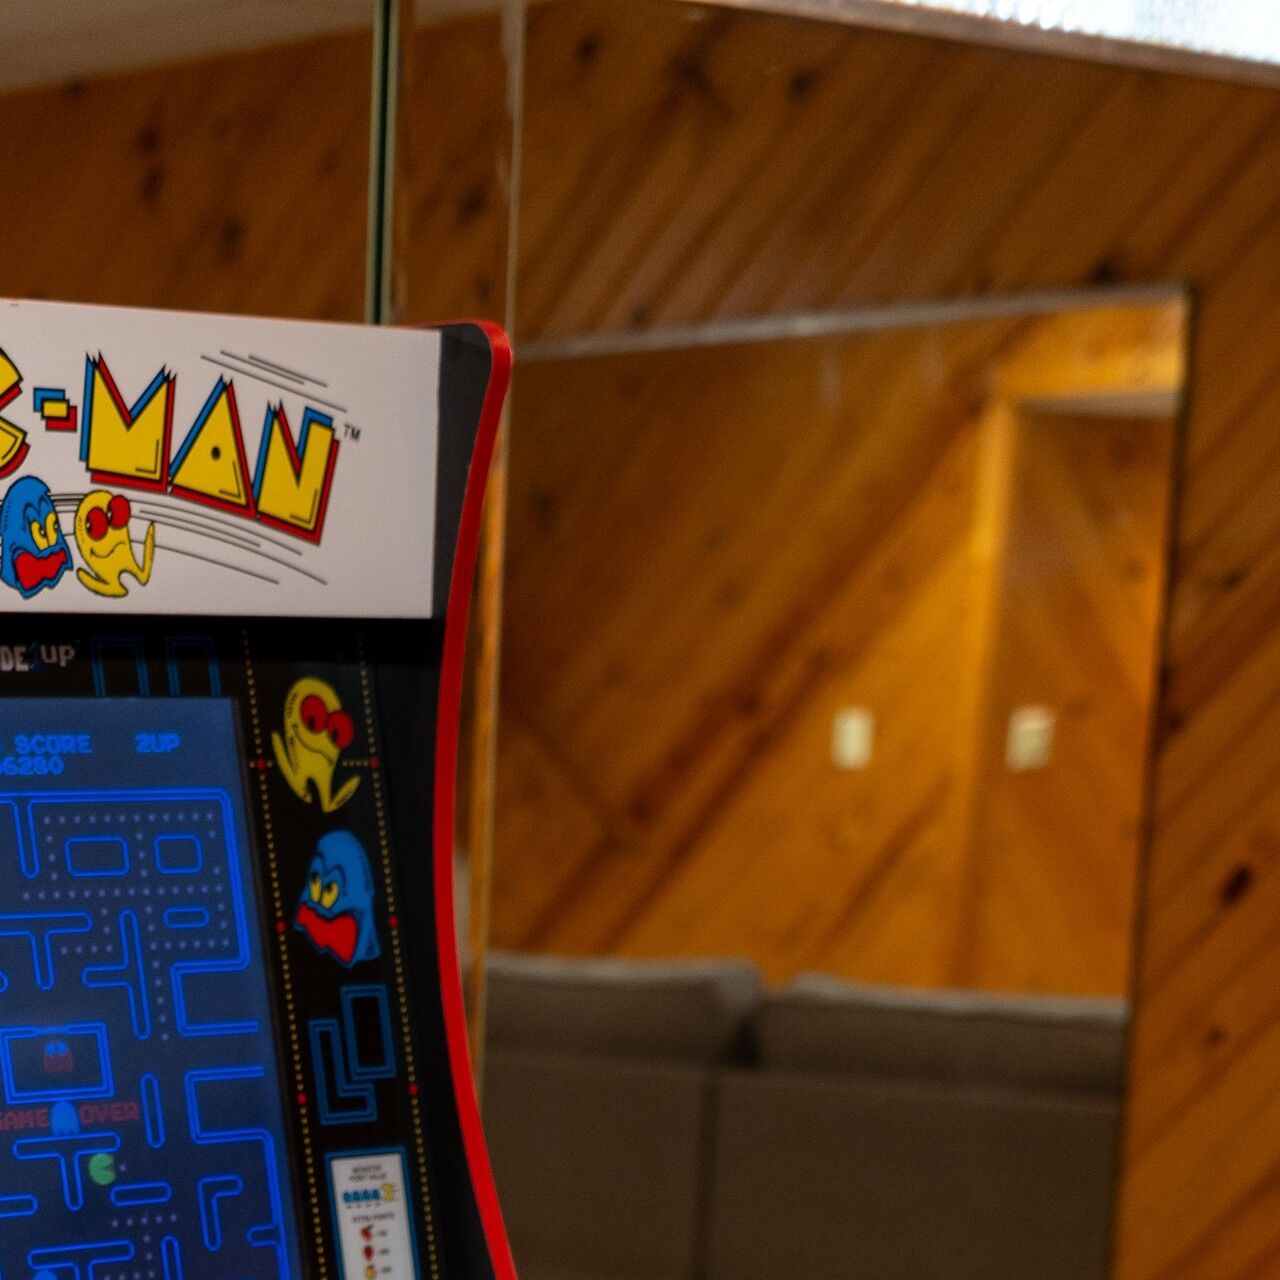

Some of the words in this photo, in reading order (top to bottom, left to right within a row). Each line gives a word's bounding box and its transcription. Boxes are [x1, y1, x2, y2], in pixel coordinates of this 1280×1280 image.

[14, 733, 93, 755] SCORE
[135, 732, 181, 754] 2UP
[79, 1101, 141, 1125] OVER
